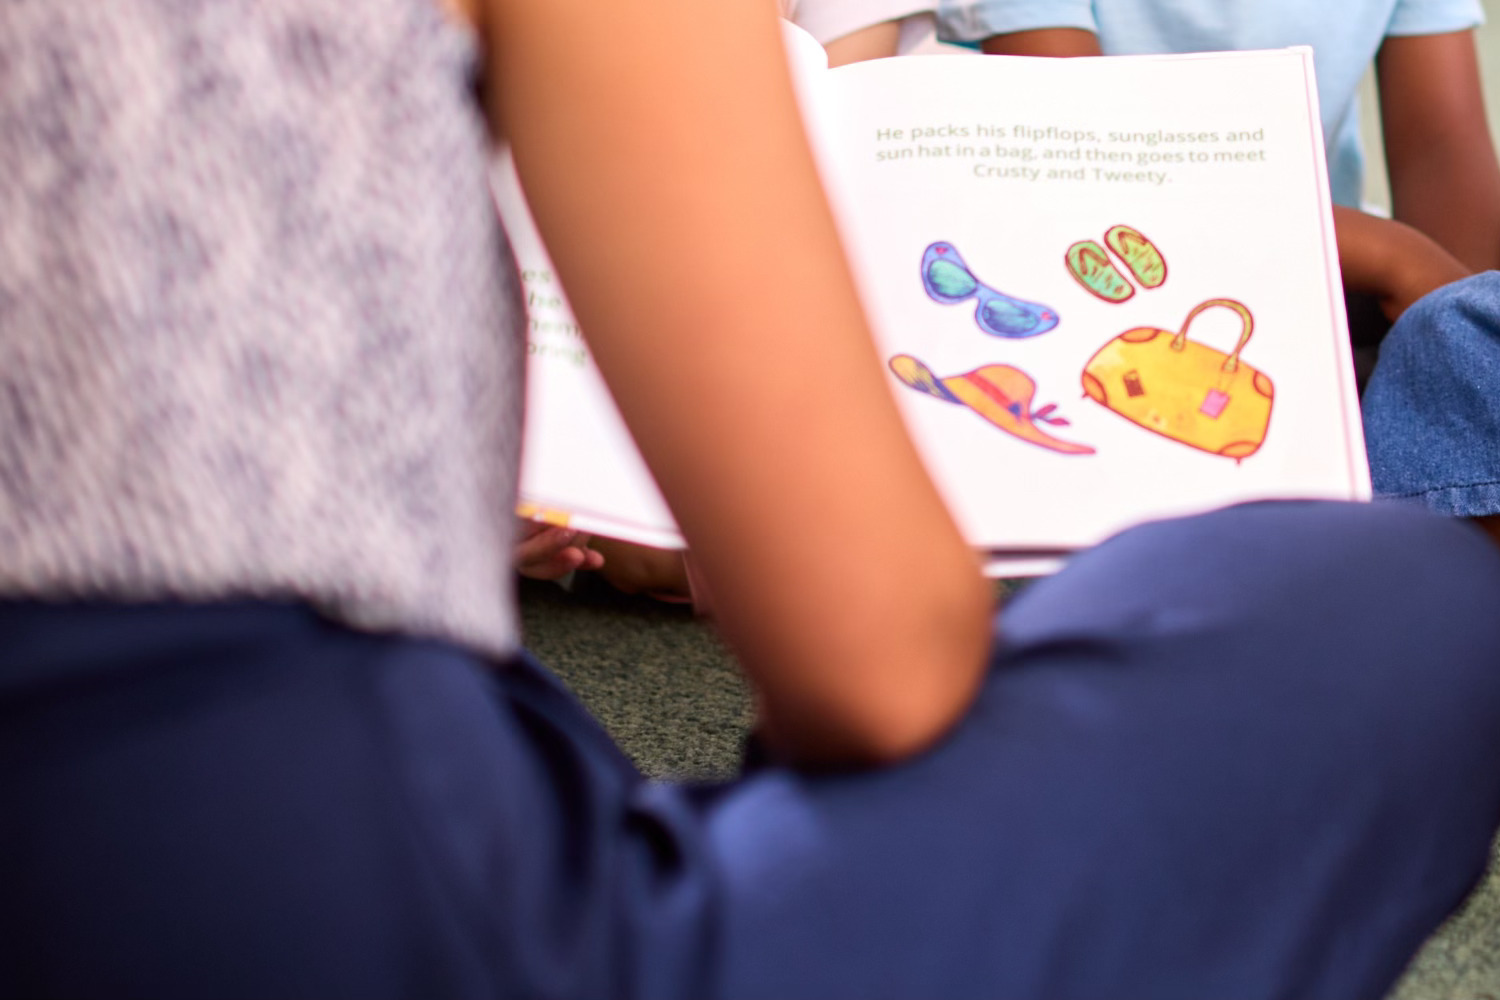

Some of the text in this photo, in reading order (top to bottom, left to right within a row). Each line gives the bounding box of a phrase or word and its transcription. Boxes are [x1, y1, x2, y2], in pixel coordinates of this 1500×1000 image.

[876, 124, 1265, 147] He packs his flipflops, sunglasses and
[875, 147, 913, 162] sun
[918, 144, 951, 157] hat
[956, 144, 975, 157] in
[979, 146, 992, 157] a
[1043, 147, 1081, 160] and
[1086, 148, 1132, 162] then
[1136, 151, 1184, 166] goes
[1189, 151, 1209, 162] to
[1214, 150, 1266, 162] meet
[973, 163, 1173, 185] Crusty and Tweety.
